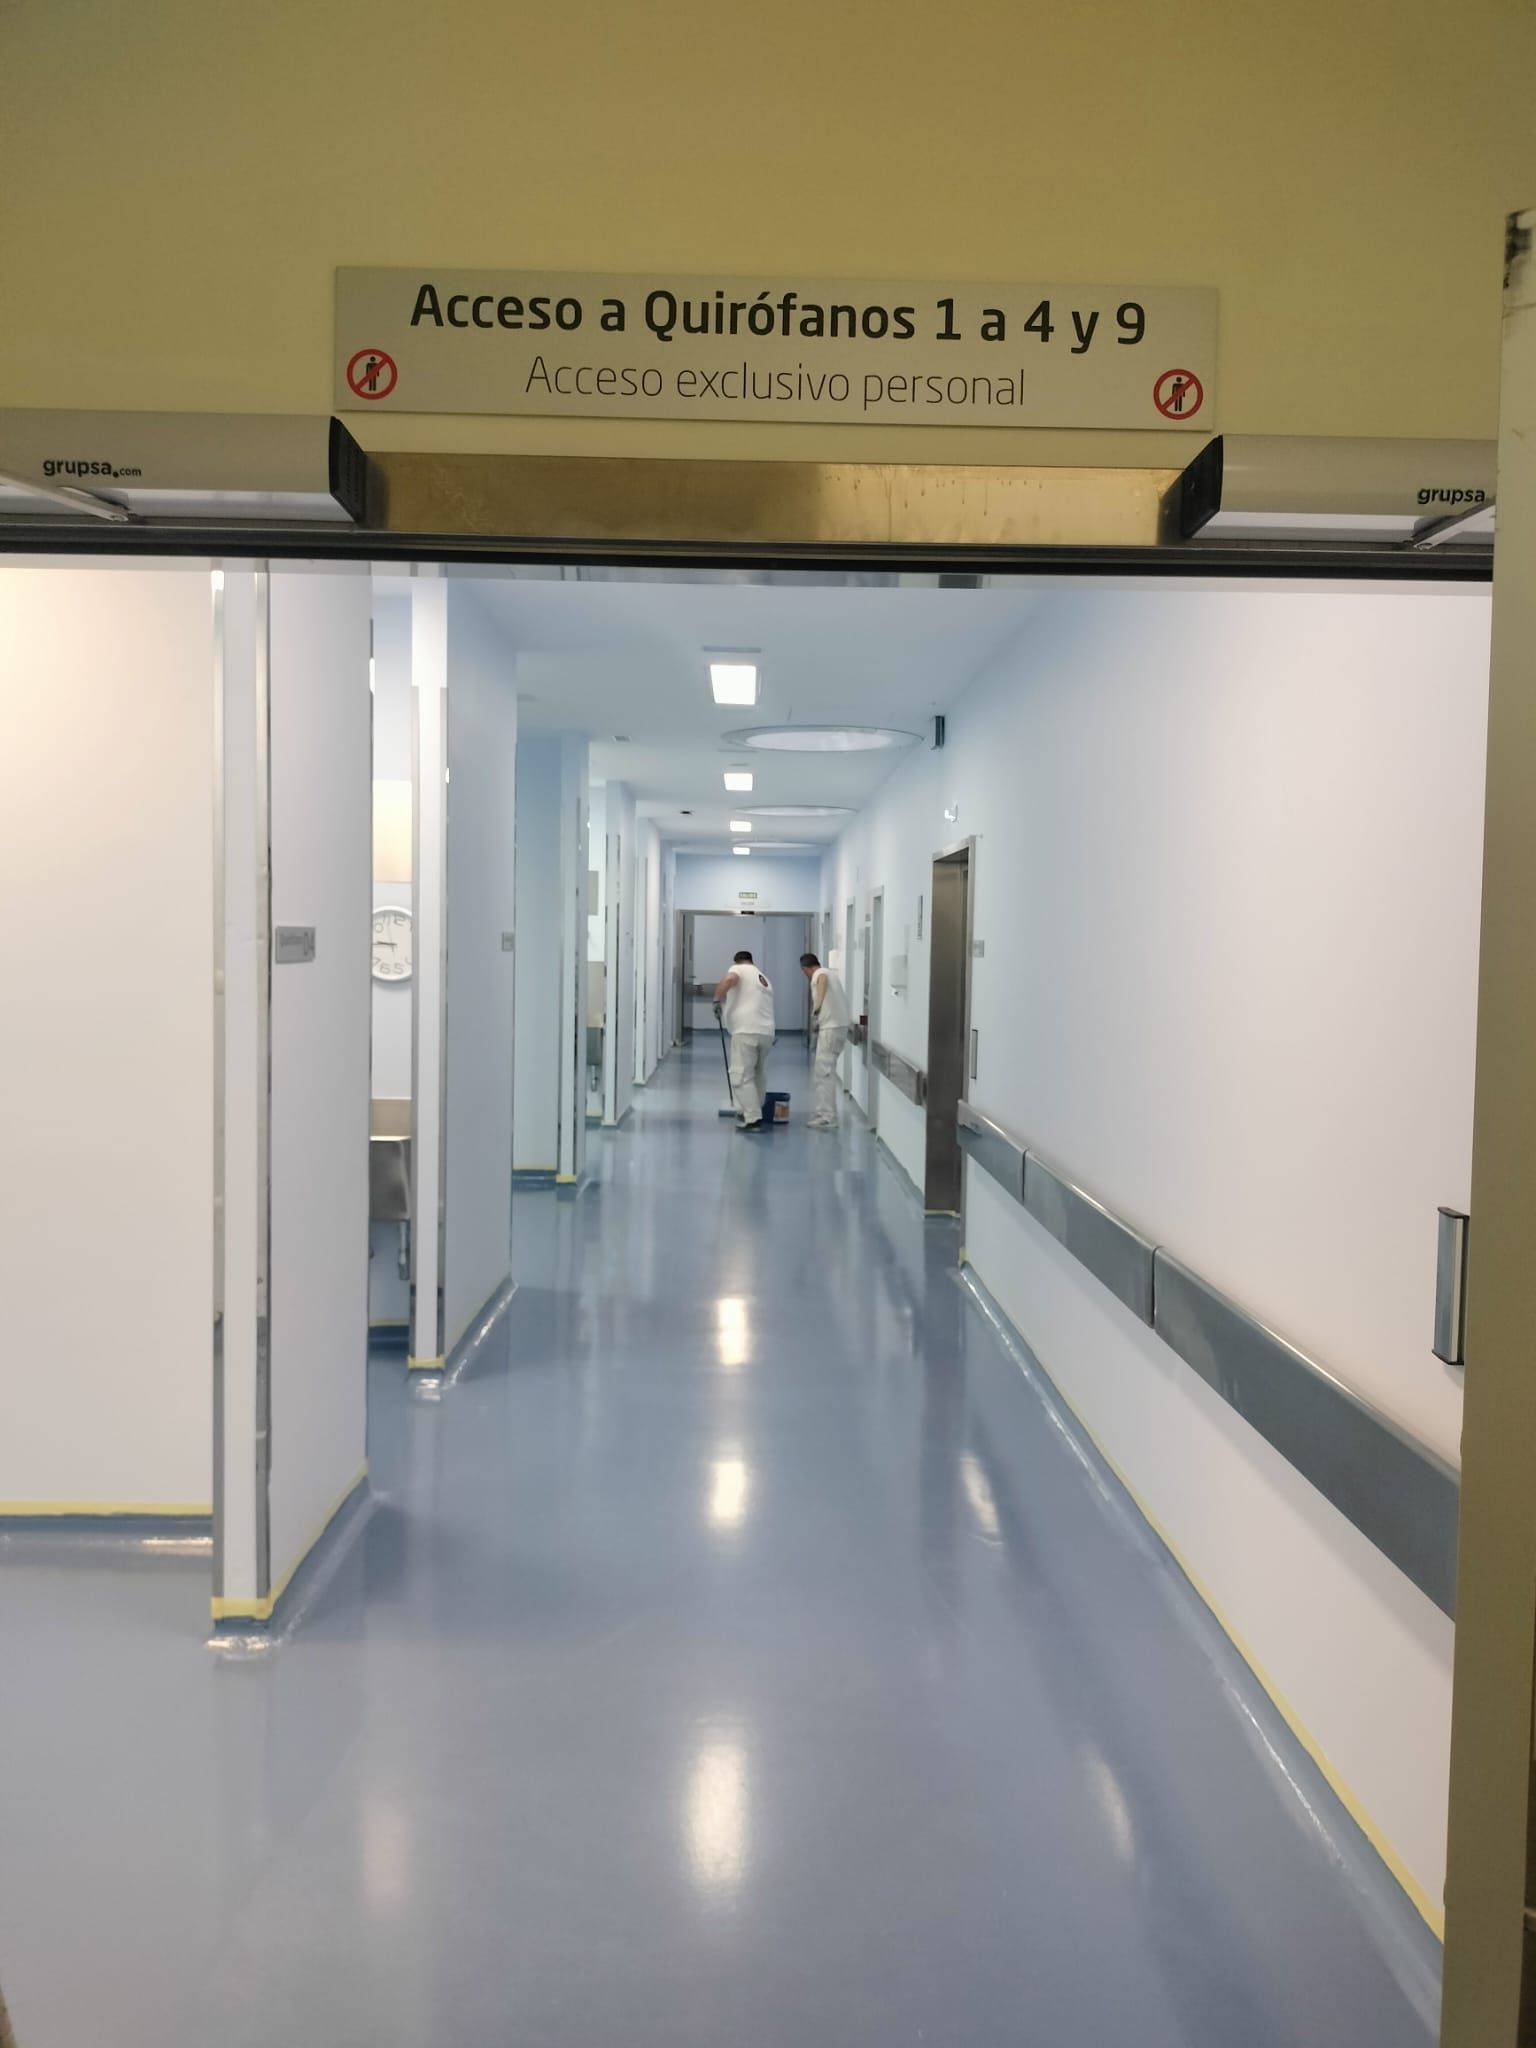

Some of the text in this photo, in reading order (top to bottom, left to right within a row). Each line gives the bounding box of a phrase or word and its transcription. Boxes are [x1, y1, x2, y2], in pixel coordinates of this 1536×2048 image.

[410, 284, 1146, 354] Acceso a Quirófanos 1 a 4 y 9
[525, 355, 1025, 412] Acceso exclusivo personal
[43, 459, 142, 477] grupsa.com
